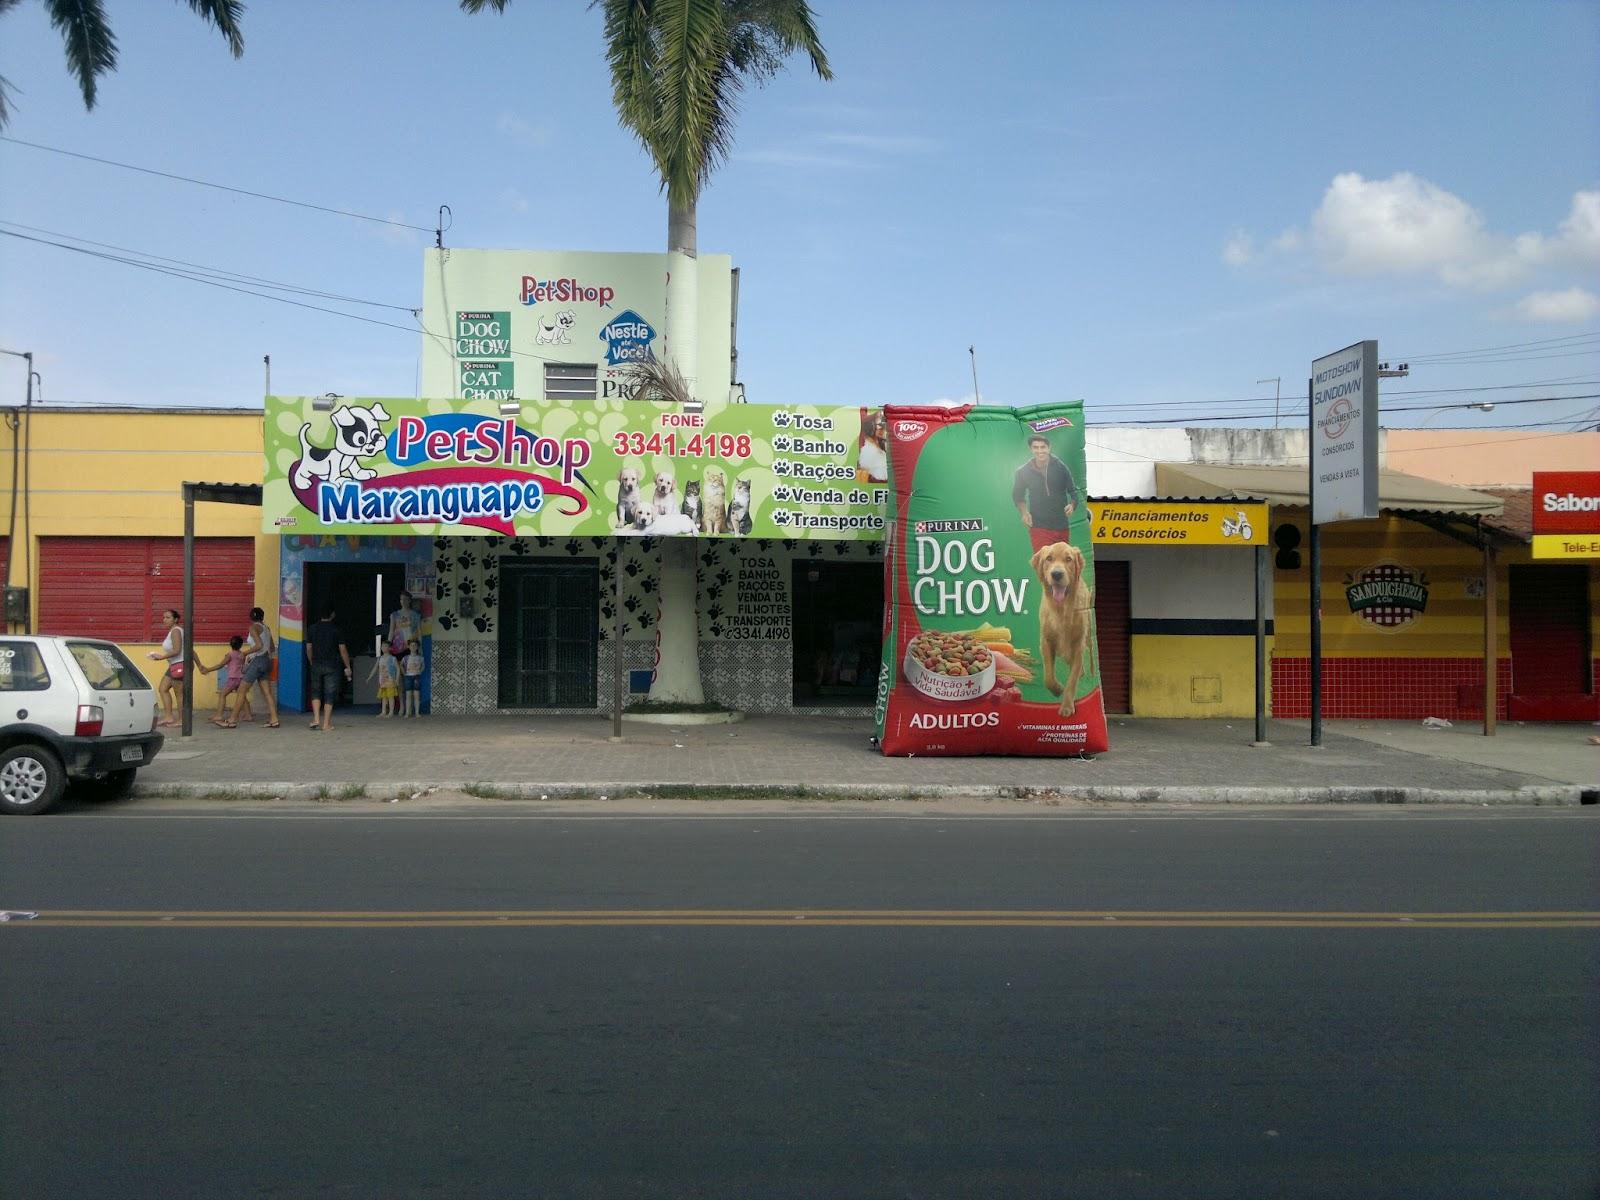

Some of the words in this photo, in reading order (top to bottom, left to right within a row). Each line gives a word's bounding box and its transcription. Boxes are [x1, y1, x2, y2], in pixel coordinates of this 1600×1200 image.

[520, 275, 615, 308] PetShop
[460, 321, 501, 337] DOG
[605, 322, 649, 341] Nestlé
[457, 338, 510, 355] CHOW
[461, 371, 502, 386] CAT
[1314, 358, 1362, 385] MOTOSHOW
[1314, 378, 1362, 406] SUNDOWN
[661, 414, 704, 427] FONE:
[793, 415, 833, 429] Tosa
[1317, 409, 1361, 428] FINANCIAMENTOS
[897, 423, 924, 431] 100%
[396, 415, 592, 485] PetShop
[613, 432, 751, 458] 3341.4198
[793, 439, 846, 454] Banho
[793, 463, 855, 482] Rações
[1319, 472, 1340, 483] VENDAS
[1345, 468, 1360, 478] VISTA
[319, 480, 542, 523] Maranguape
[792, 489, 844, 504] Venda
[849, 489, 868, 503] de
[792, 513, 884, 531] Transporte
[1100, 509, 1209, 522] Financiamentos
[926, 520, 981, 532] PURINA
[1096, 527, 1107, 538] &
[1112, 526, 1187, 539] Consórcios
[1562, 542, 1600, 553] Tele-E
[740, 558, 776, 568] TOSA
[915, 536, 995, 575] DOG
[739, 570, 780, 580] BANHO
[737, 592, 771, 602] VENDA
[775, 592, 788, 602] DE
[914, 578, 1030, 616] CHOW
[738, 604, 791, 614] FILHOTES
[725, 616, 791, 626] TRANSPORTE
[733, 627, 791, 640] 3341.4198
[915, 677, 932, 693] Vida
[934, 686, 981, 698] Saudável
[919, 671, 963, 689] Nutrição
[909, 712, 1000, 729] ADULTOS
